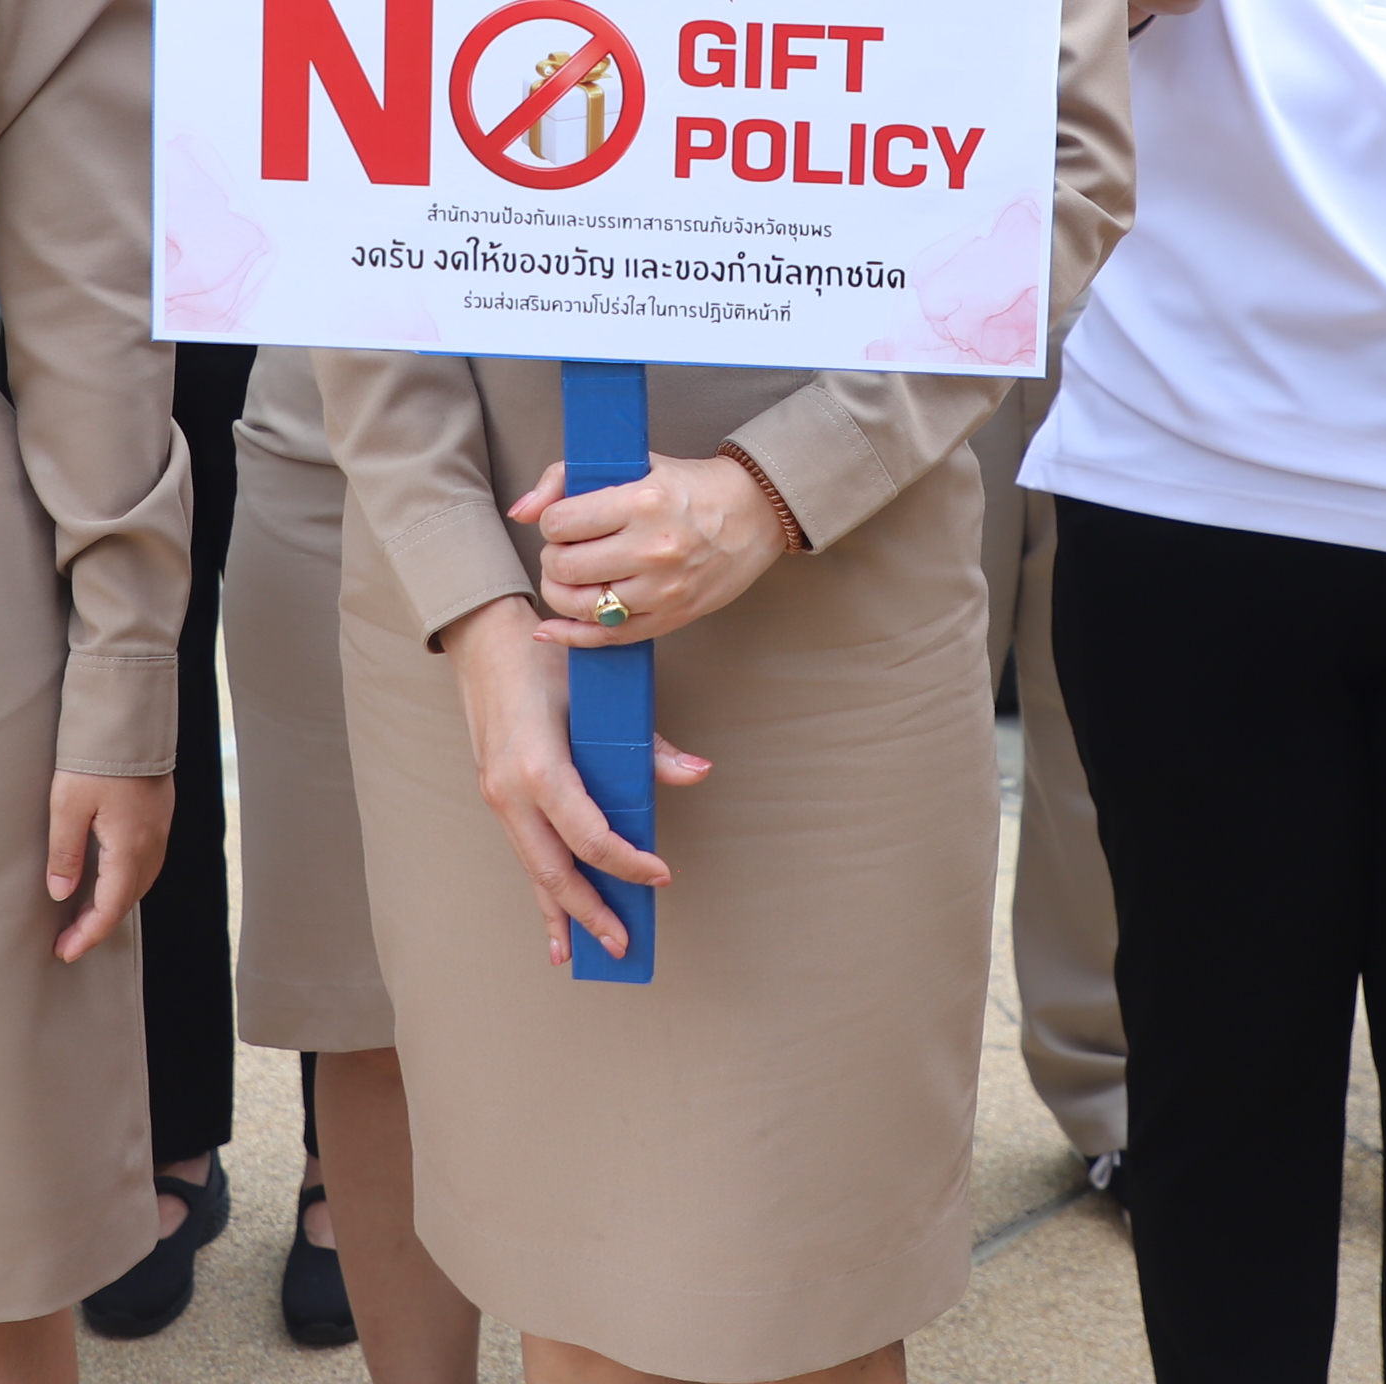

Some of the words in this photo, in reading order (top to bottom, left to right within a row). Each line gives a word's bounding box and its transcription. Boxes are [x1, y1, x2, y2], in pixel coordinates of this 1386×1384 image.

[677, 19, 885, 93] GIFT
[674, 115, 986, 190] POLICY
[427, 203, 833, 242] สำนักงานป้องกันและบรรเทาสาธารณภัยจังหวัดชุมพร
[351, 238, 425, 270] งดรับ
[433, 236, 615, 280] งดให้ของขวัญ
[624, 250, 906, 297] และของกำนัลทุกชนิด
